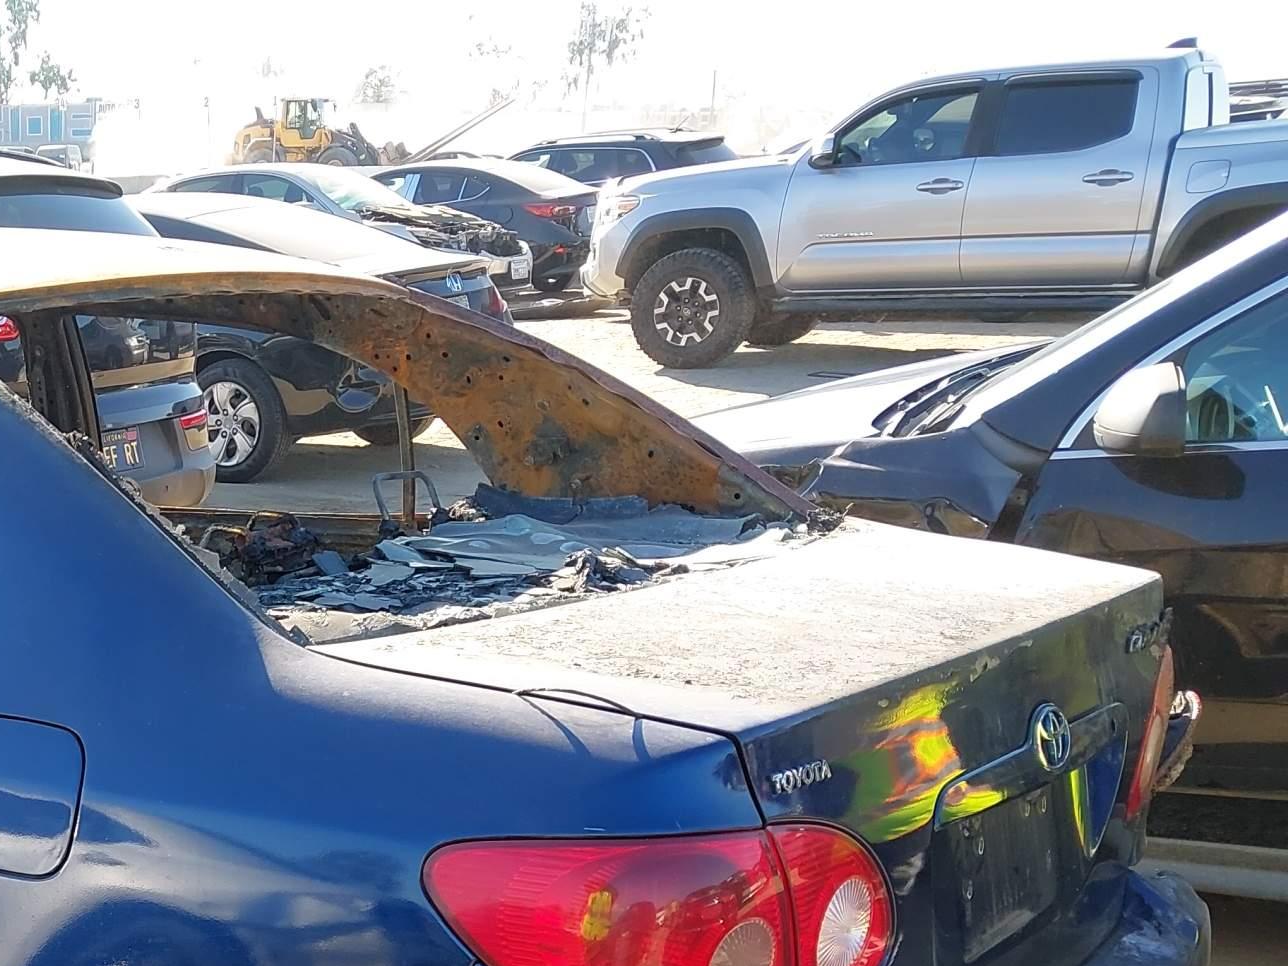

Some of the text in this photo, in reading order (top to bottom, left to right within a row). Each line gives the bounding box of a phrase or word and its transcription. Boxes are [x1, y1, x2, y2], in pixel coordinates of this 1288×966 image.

[133, 97, 140, 109] 3
[203, 96, 210, 108] 2
[772, 759, 832, 794] TOYOTA
